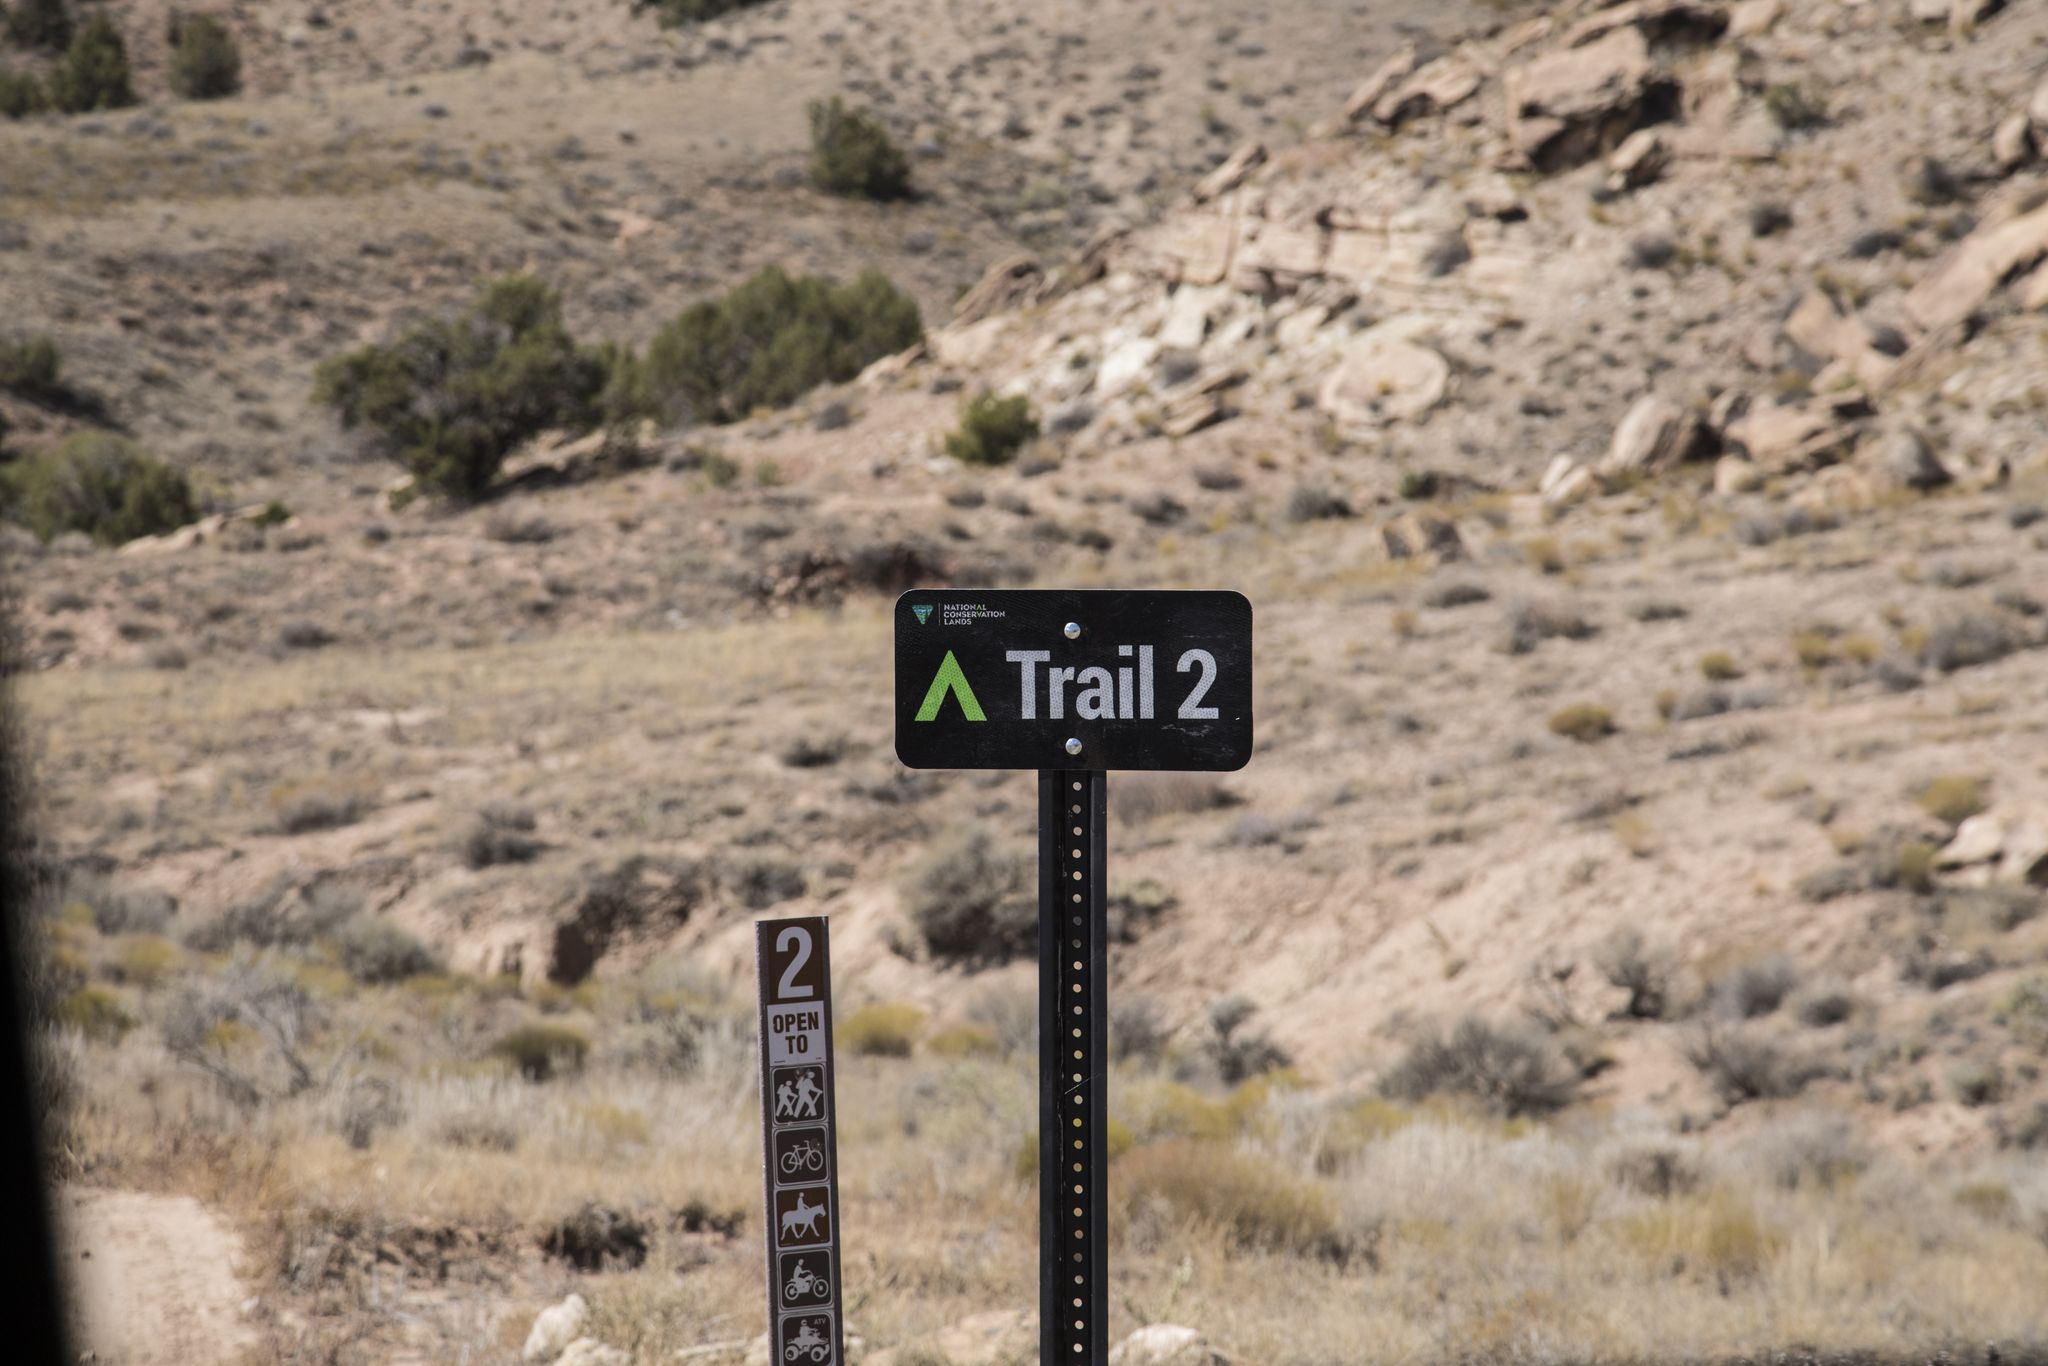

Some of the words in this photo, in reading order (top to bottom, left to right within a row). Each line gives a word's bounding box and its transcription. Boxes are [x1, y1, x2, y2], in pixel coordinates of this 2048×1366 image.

[1006, 644, 1154, 720] Trail
[1176, 648, 1219, 720] 2
[776, 926, 813, 999] 2
[772, 1011, 819, 1034] OPEN
[785, 1034, 808, 1055] TO
[813, 1317, 827, 1325] ATV
